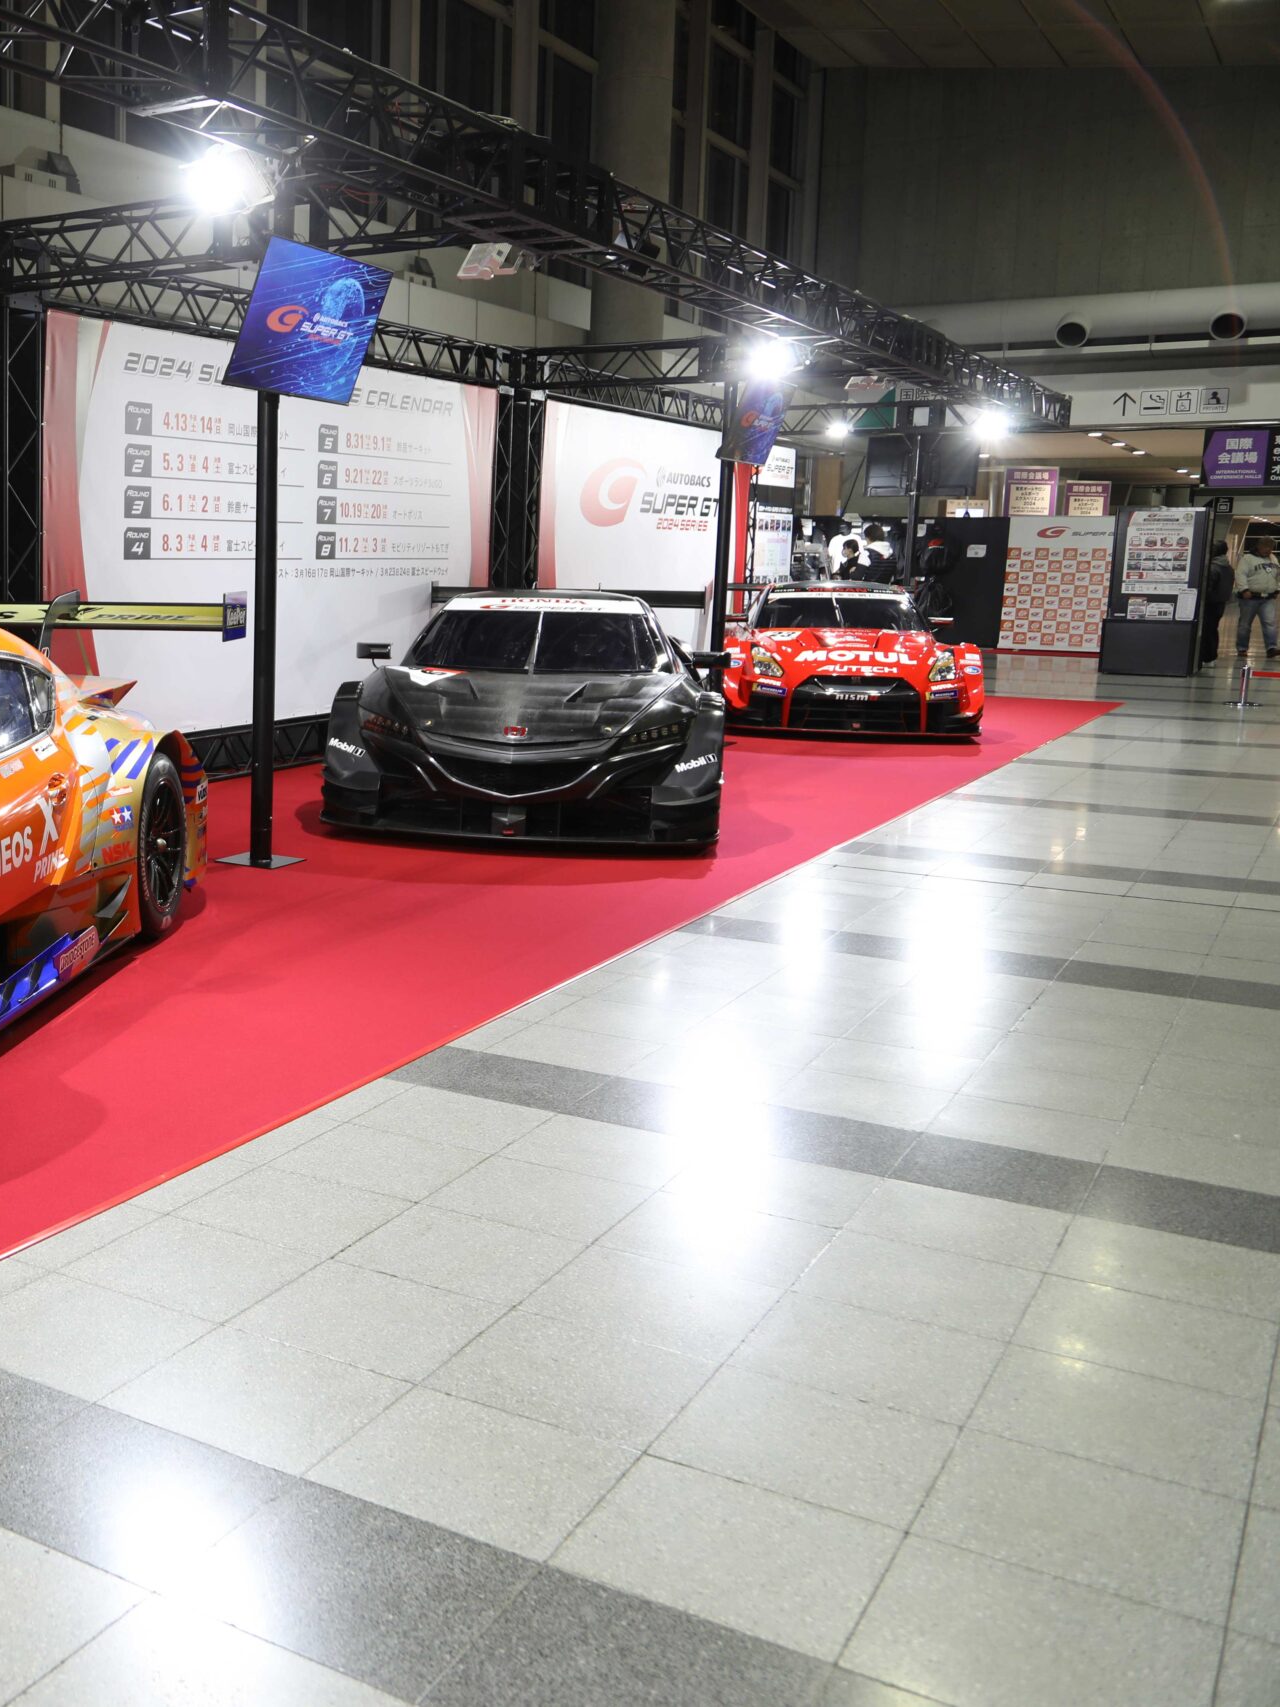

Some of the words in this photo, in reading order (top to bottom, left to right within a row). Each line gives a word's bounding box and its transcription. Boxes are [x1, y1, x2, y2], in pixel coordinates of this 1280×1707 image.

[300, 321, 338, 338] SUPER
[337, 328, 354, 340] GT
[123, 351, 193, 379] 2024
[127, 405, 151, 414] ROUND
[365, 389, 454, 416] CALENDAR
[135, 417, 143, 431] 1
[163, 411, 188, 432] 4.13
[200, 415, 213, 434] 14
[323, 438, 334, 449] 5
[346, 432, 364, 449] 8.31
[372, 435, 385, 451] 9.1
[1225, 437, 1253, 450] 国際
[126, 447, 150, 457] ROUND
[1218, 451, 1258, 464] 会議場
[132, 459, 144, 473] 2
[202, 456, 209, 473] 4
[322, 473, 332, 485] 6
[345, 468, 363, 484] 9.21
[372, 470, 382, 486] 22
[666, 472, 711, 488] AUTOBACS
[1013, 471, 1050, 480] 国際会議場
[126, 489, 150, 498] ROUND
[1072, 485, 1103, 493] 国際会議場
[131, 501, 144, 514] 3
[201, 496, 208, 513] 2
[340, 502, 362, 518] 10.19
[370, 503, 381, 519] 20
[639, 491, 698, 516] SUPER
[700, 496, 720, 517] GT
[322, 509, 332, 520] 7
[656, 517, 679, 531] 2024
[679, 518, 708, 532] SERIES
[126, 531, 150, 539] ROUND
[131, 542, 144, 555] 4
[200, 535, 208, 552] 4
[320, 544, 331, 556] 8
[372, 537, 378, 553] 3
[501, 597, 587, 605] HONDA
[793, 650, 917, 665] MOTUL
[816, 664, 899, 673] AUTECH
[328, 737, 356, 754] Mobil
[675, 756, 707, 773] Mobil
[101, 841, 135, 864] NSK
